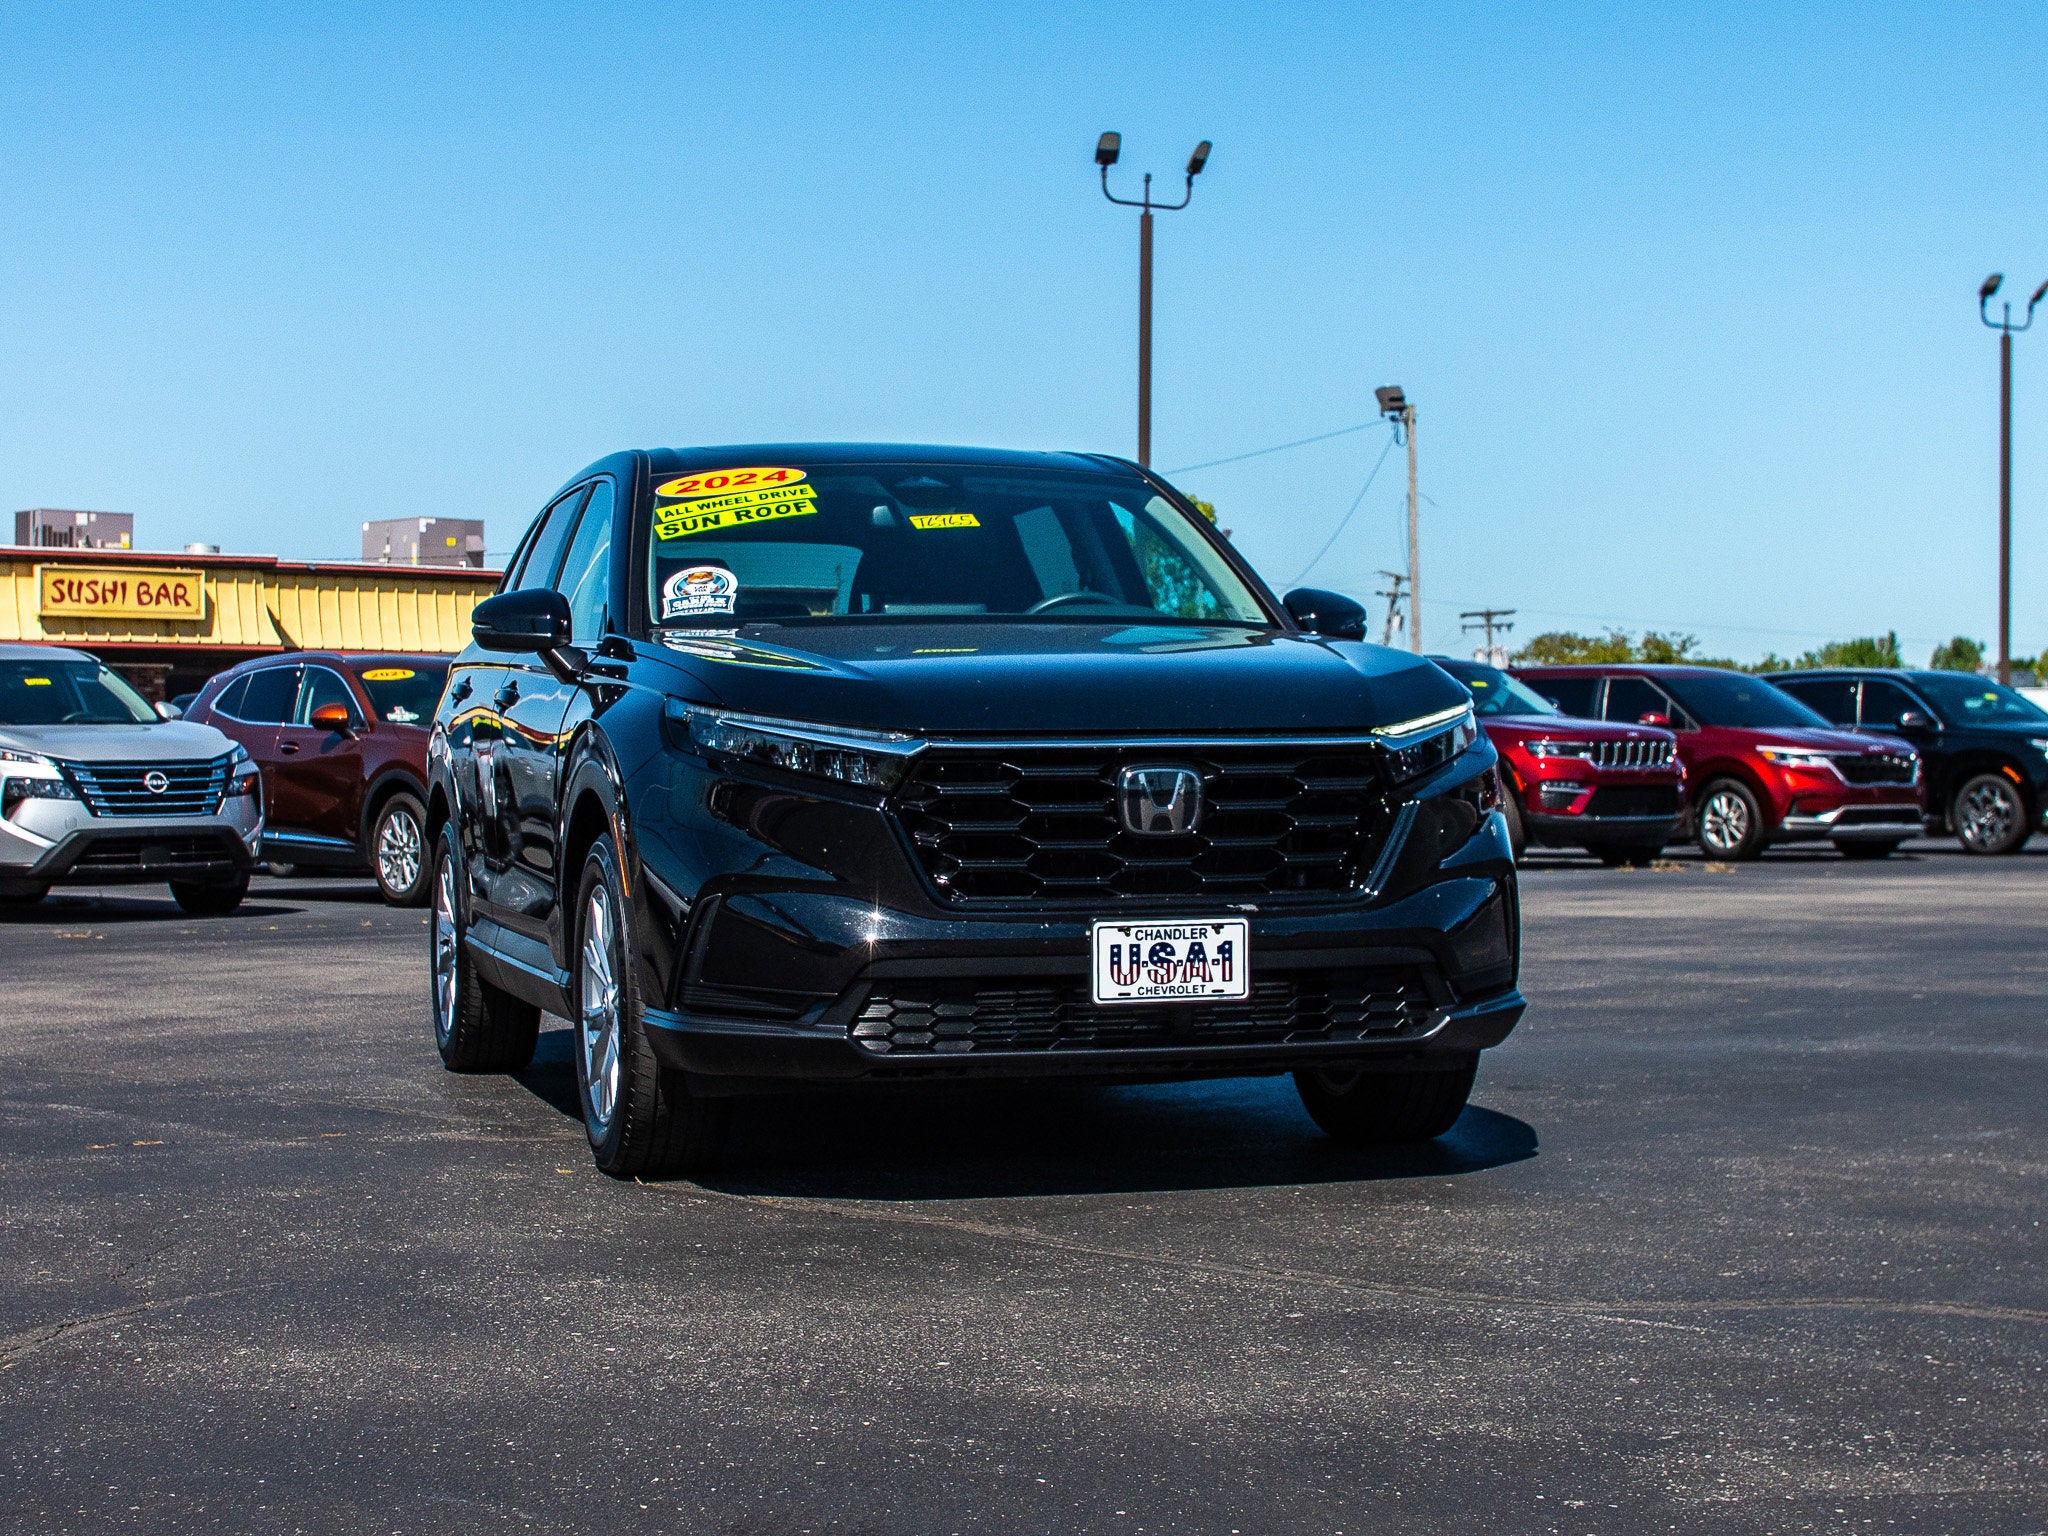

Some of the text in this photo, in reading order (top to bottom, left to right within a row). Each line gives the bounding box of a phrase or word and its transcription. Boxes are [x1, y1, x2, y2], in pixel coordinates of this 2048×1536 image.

[674, 470, 789, 495] 2024
[663, 487, 810, 519] ALL WHEEL DRIVE
[663, 501, 809, 536] SUN ROOF
[51, 578, 192, 607] SUSHI BAR
[1134, 928, 1208, 941] CHANDLER
[1137, 984, 1206, 996] CHEVROLET
